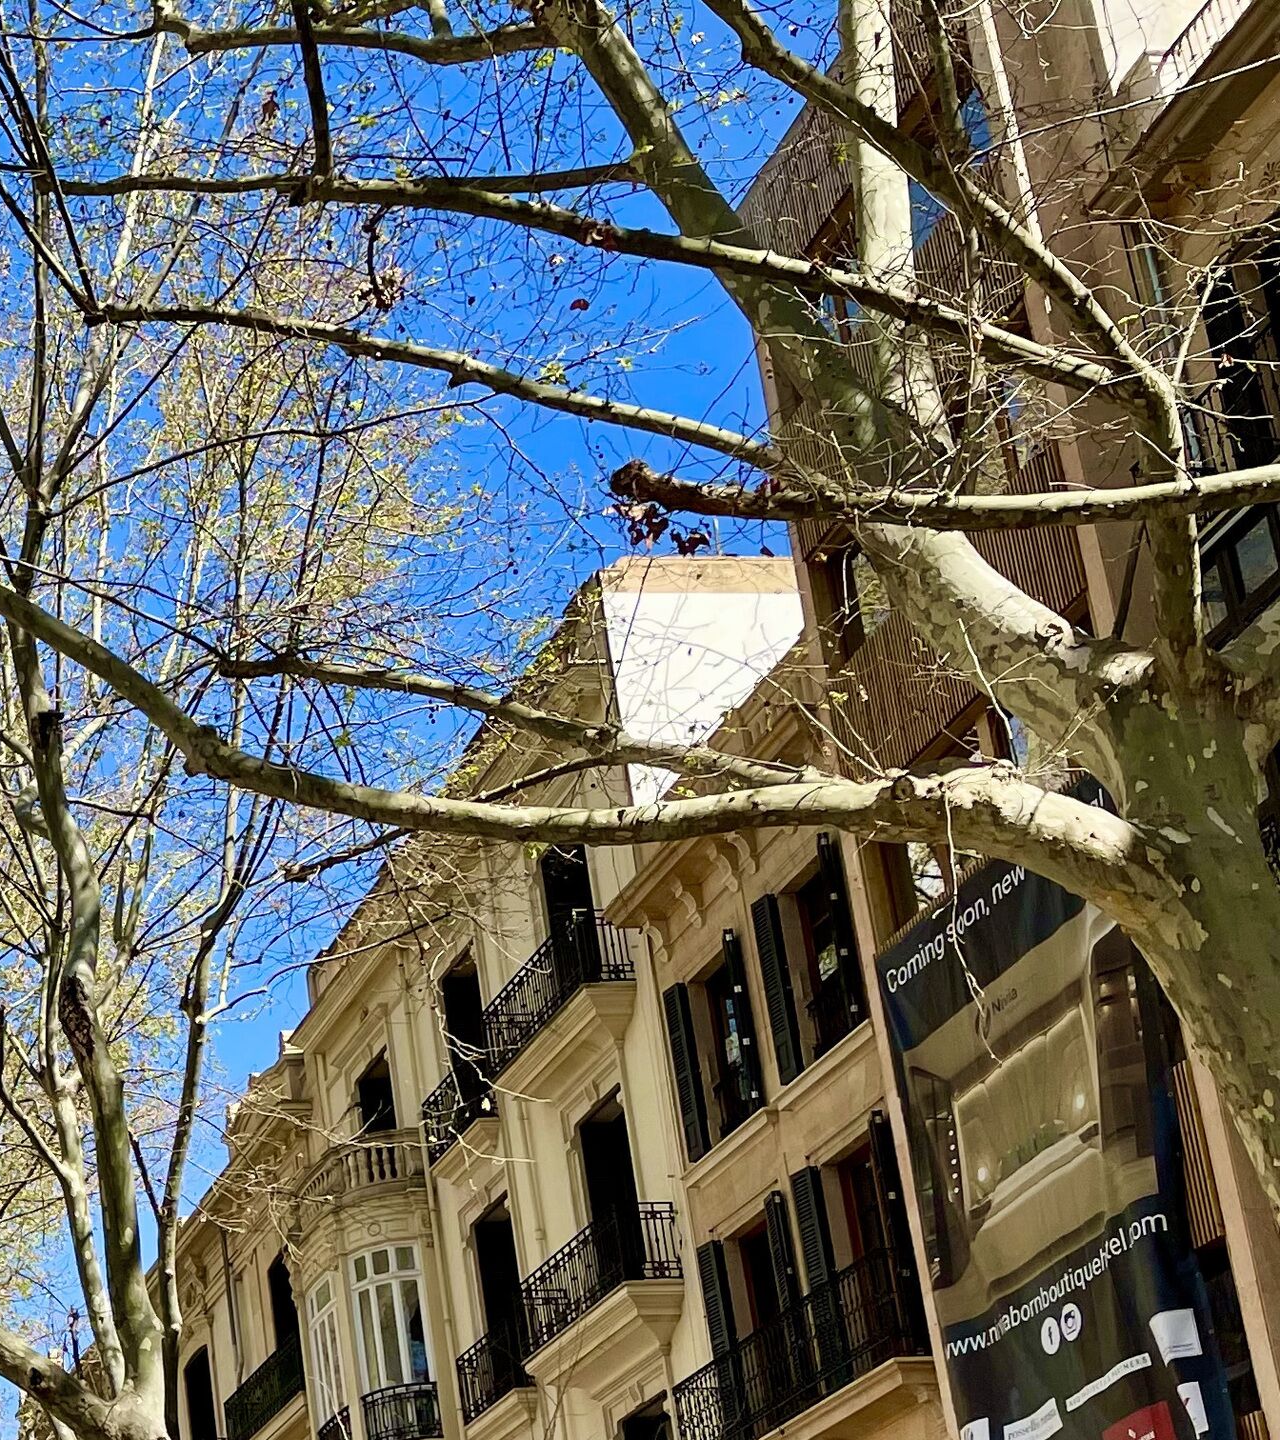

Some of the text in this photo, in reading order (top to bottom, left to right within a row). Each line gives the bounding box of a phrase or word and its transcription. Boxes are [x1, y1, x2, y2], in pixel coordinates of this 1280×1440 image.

[886, 864, 1027, 994] Coming soon, new
